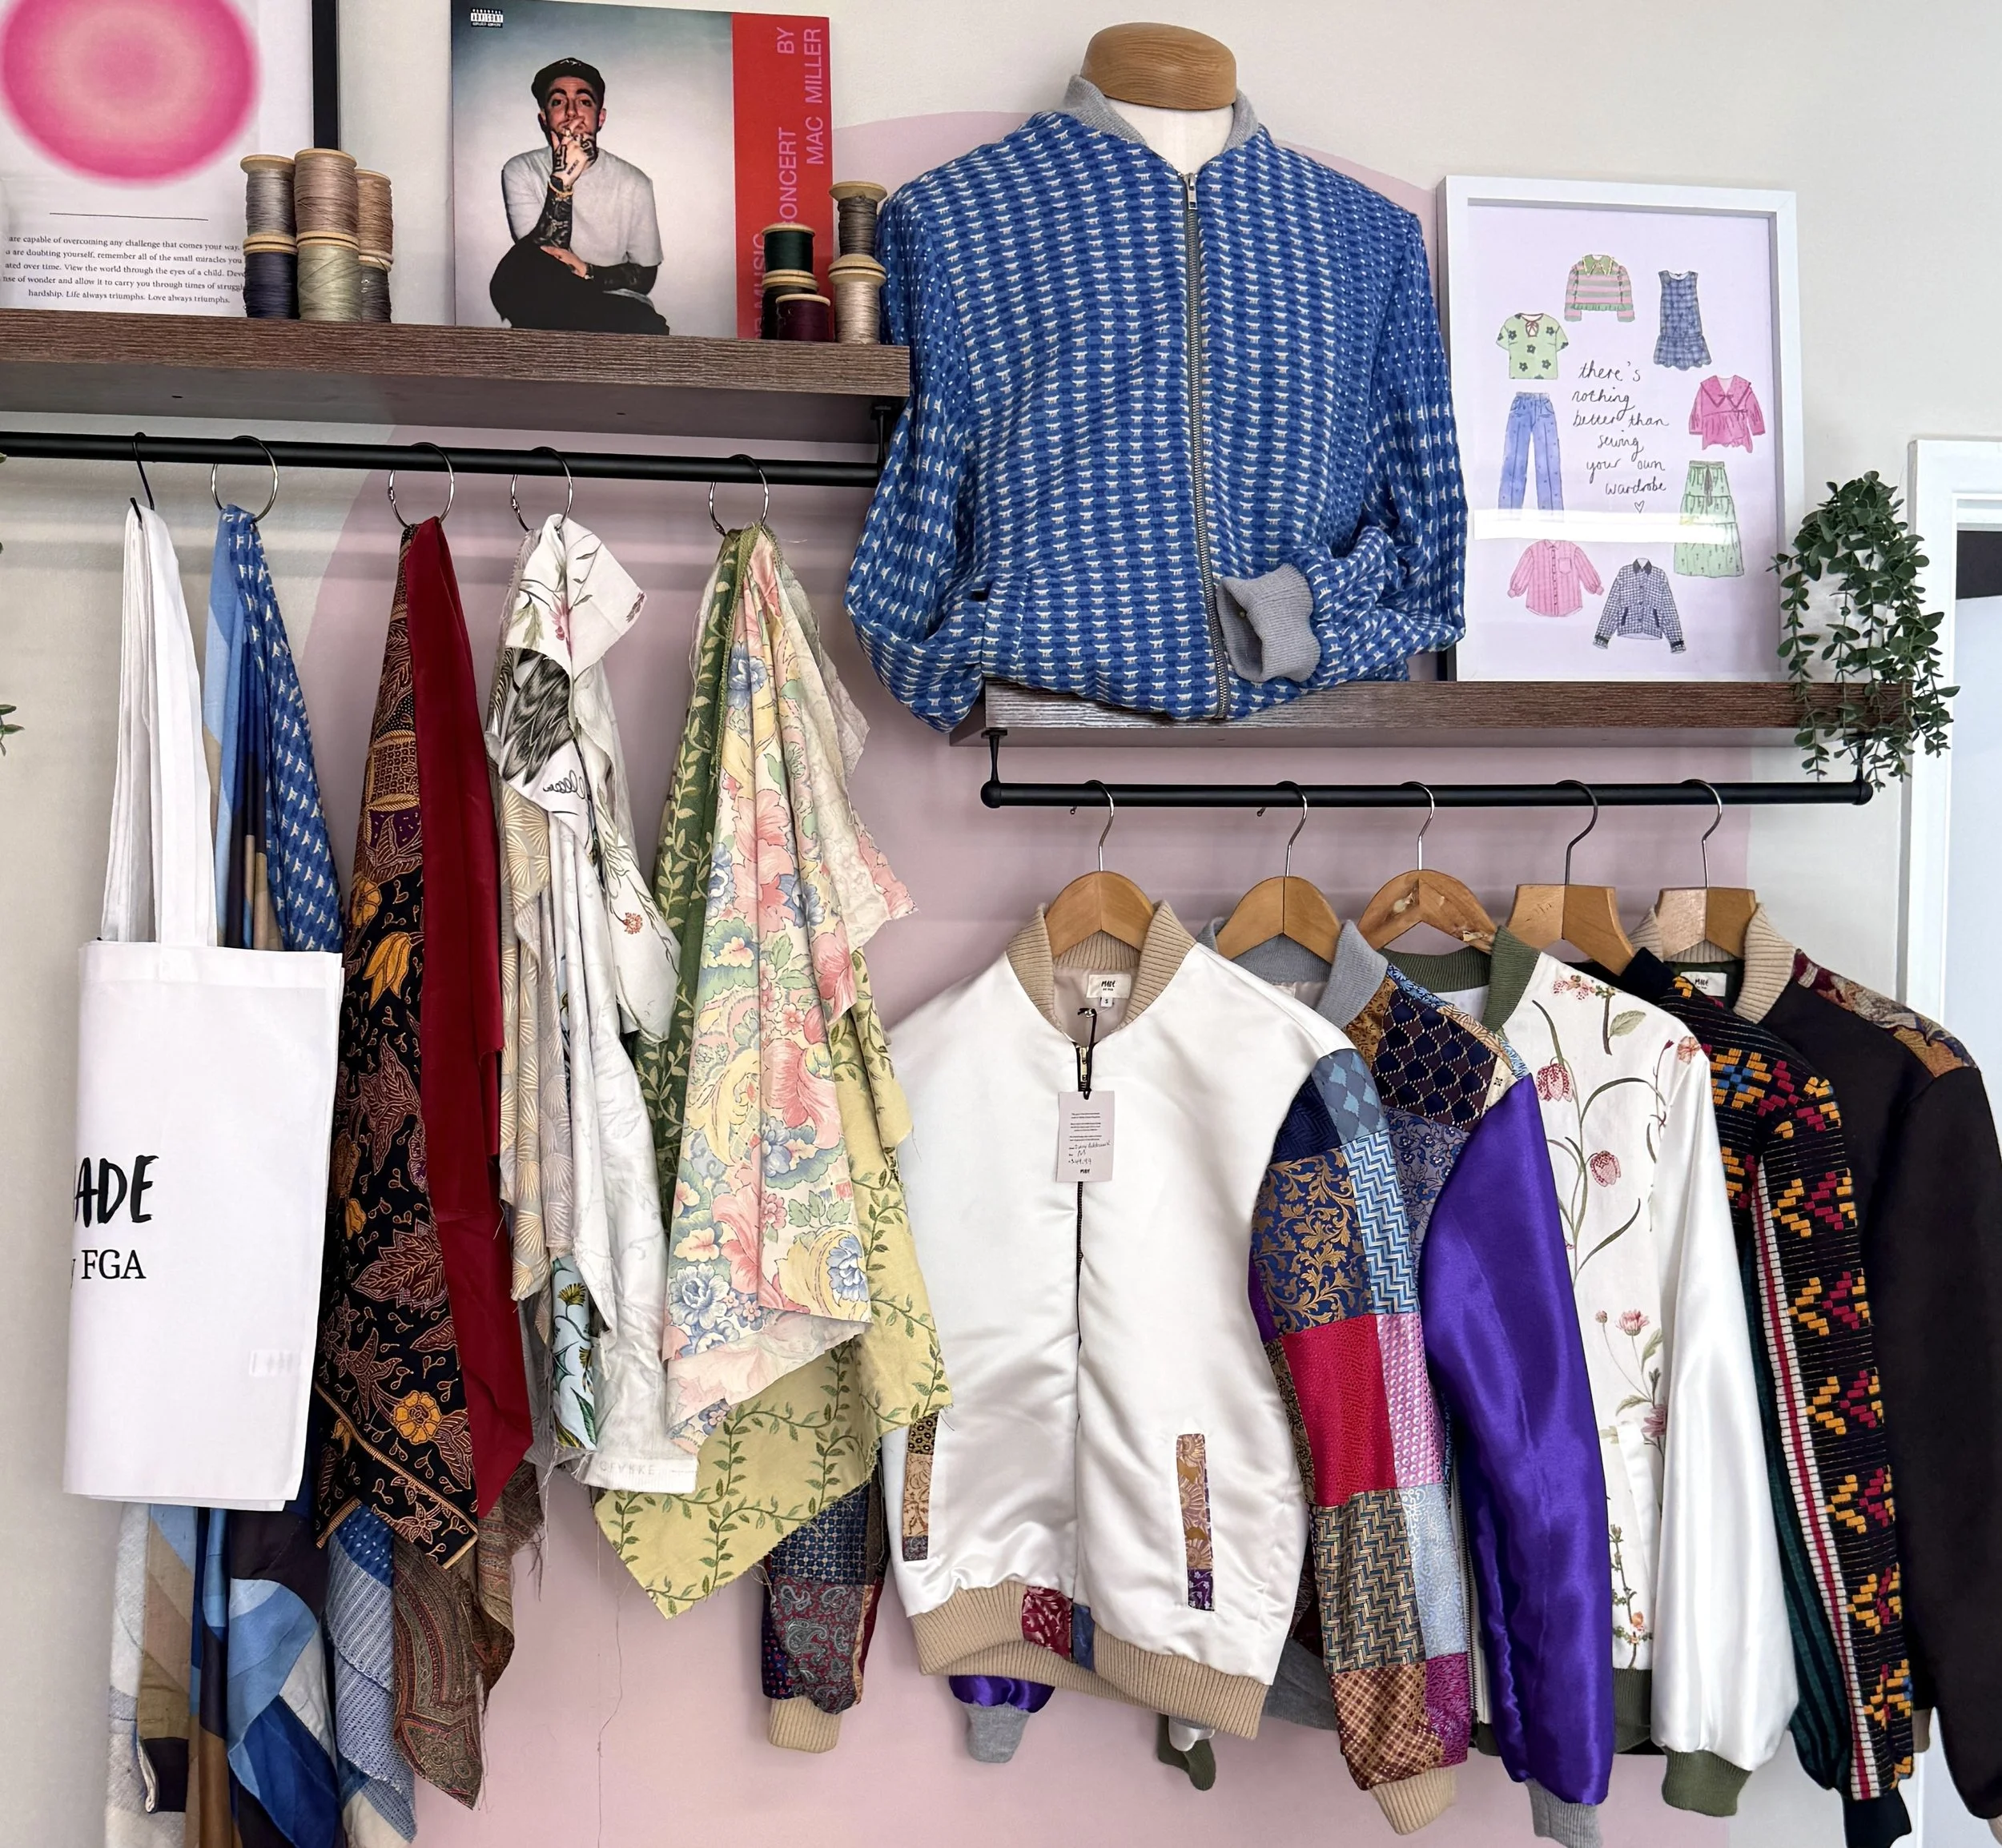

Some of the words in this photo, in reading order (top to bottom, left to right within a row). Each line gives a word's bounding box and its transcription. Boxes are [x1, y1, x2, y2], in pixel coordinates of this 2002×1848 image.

[777, 26, 794, 54] BY
[803, 29, 822, 103] MILLER
[806, 116, 824, 164] MAC
[778, 127, 798, 223] ONCERT
[23, 235, 51, 244] capable
[63, 238, 108, 247] overcoming
[125, 240, 160, 248] challenge
[26, 249, 61, 259] doubting
[97, 252, 135, 260] remember
[64, 263, 83, 271] View
[99, 265, 121, 273] world
[123, 265, 153, 275] through
[155, 267, 167, 275] the
[170, 268, 185, 276] eyes
[28, 289, 64, 298] hardship.
[82, 291, 107, 300] always
[109, 292, 146, 301] triumphs.
[148, 293, 166, 301] Love
[168, 294, 192, 303] always
[194, 295, 230, 304] triumphs.
[152, 280, 183, 289] through
[1578, 360, 1641, 382] there's
[1571, 387, 1635, 421] nothing
[1573, 410, 1619, 427] better
[1628, 412, 1670, 428] than
[1597, 430, 1644, 462] sewing
[1586, 458, 1622, 484] your
[1637, 460, 1666, 472] own
[1606, 476, 1666, 496] wardrobe
[74, 1154, 159, 1228] ADE
[81, 1249, 147, 1280] FGA
